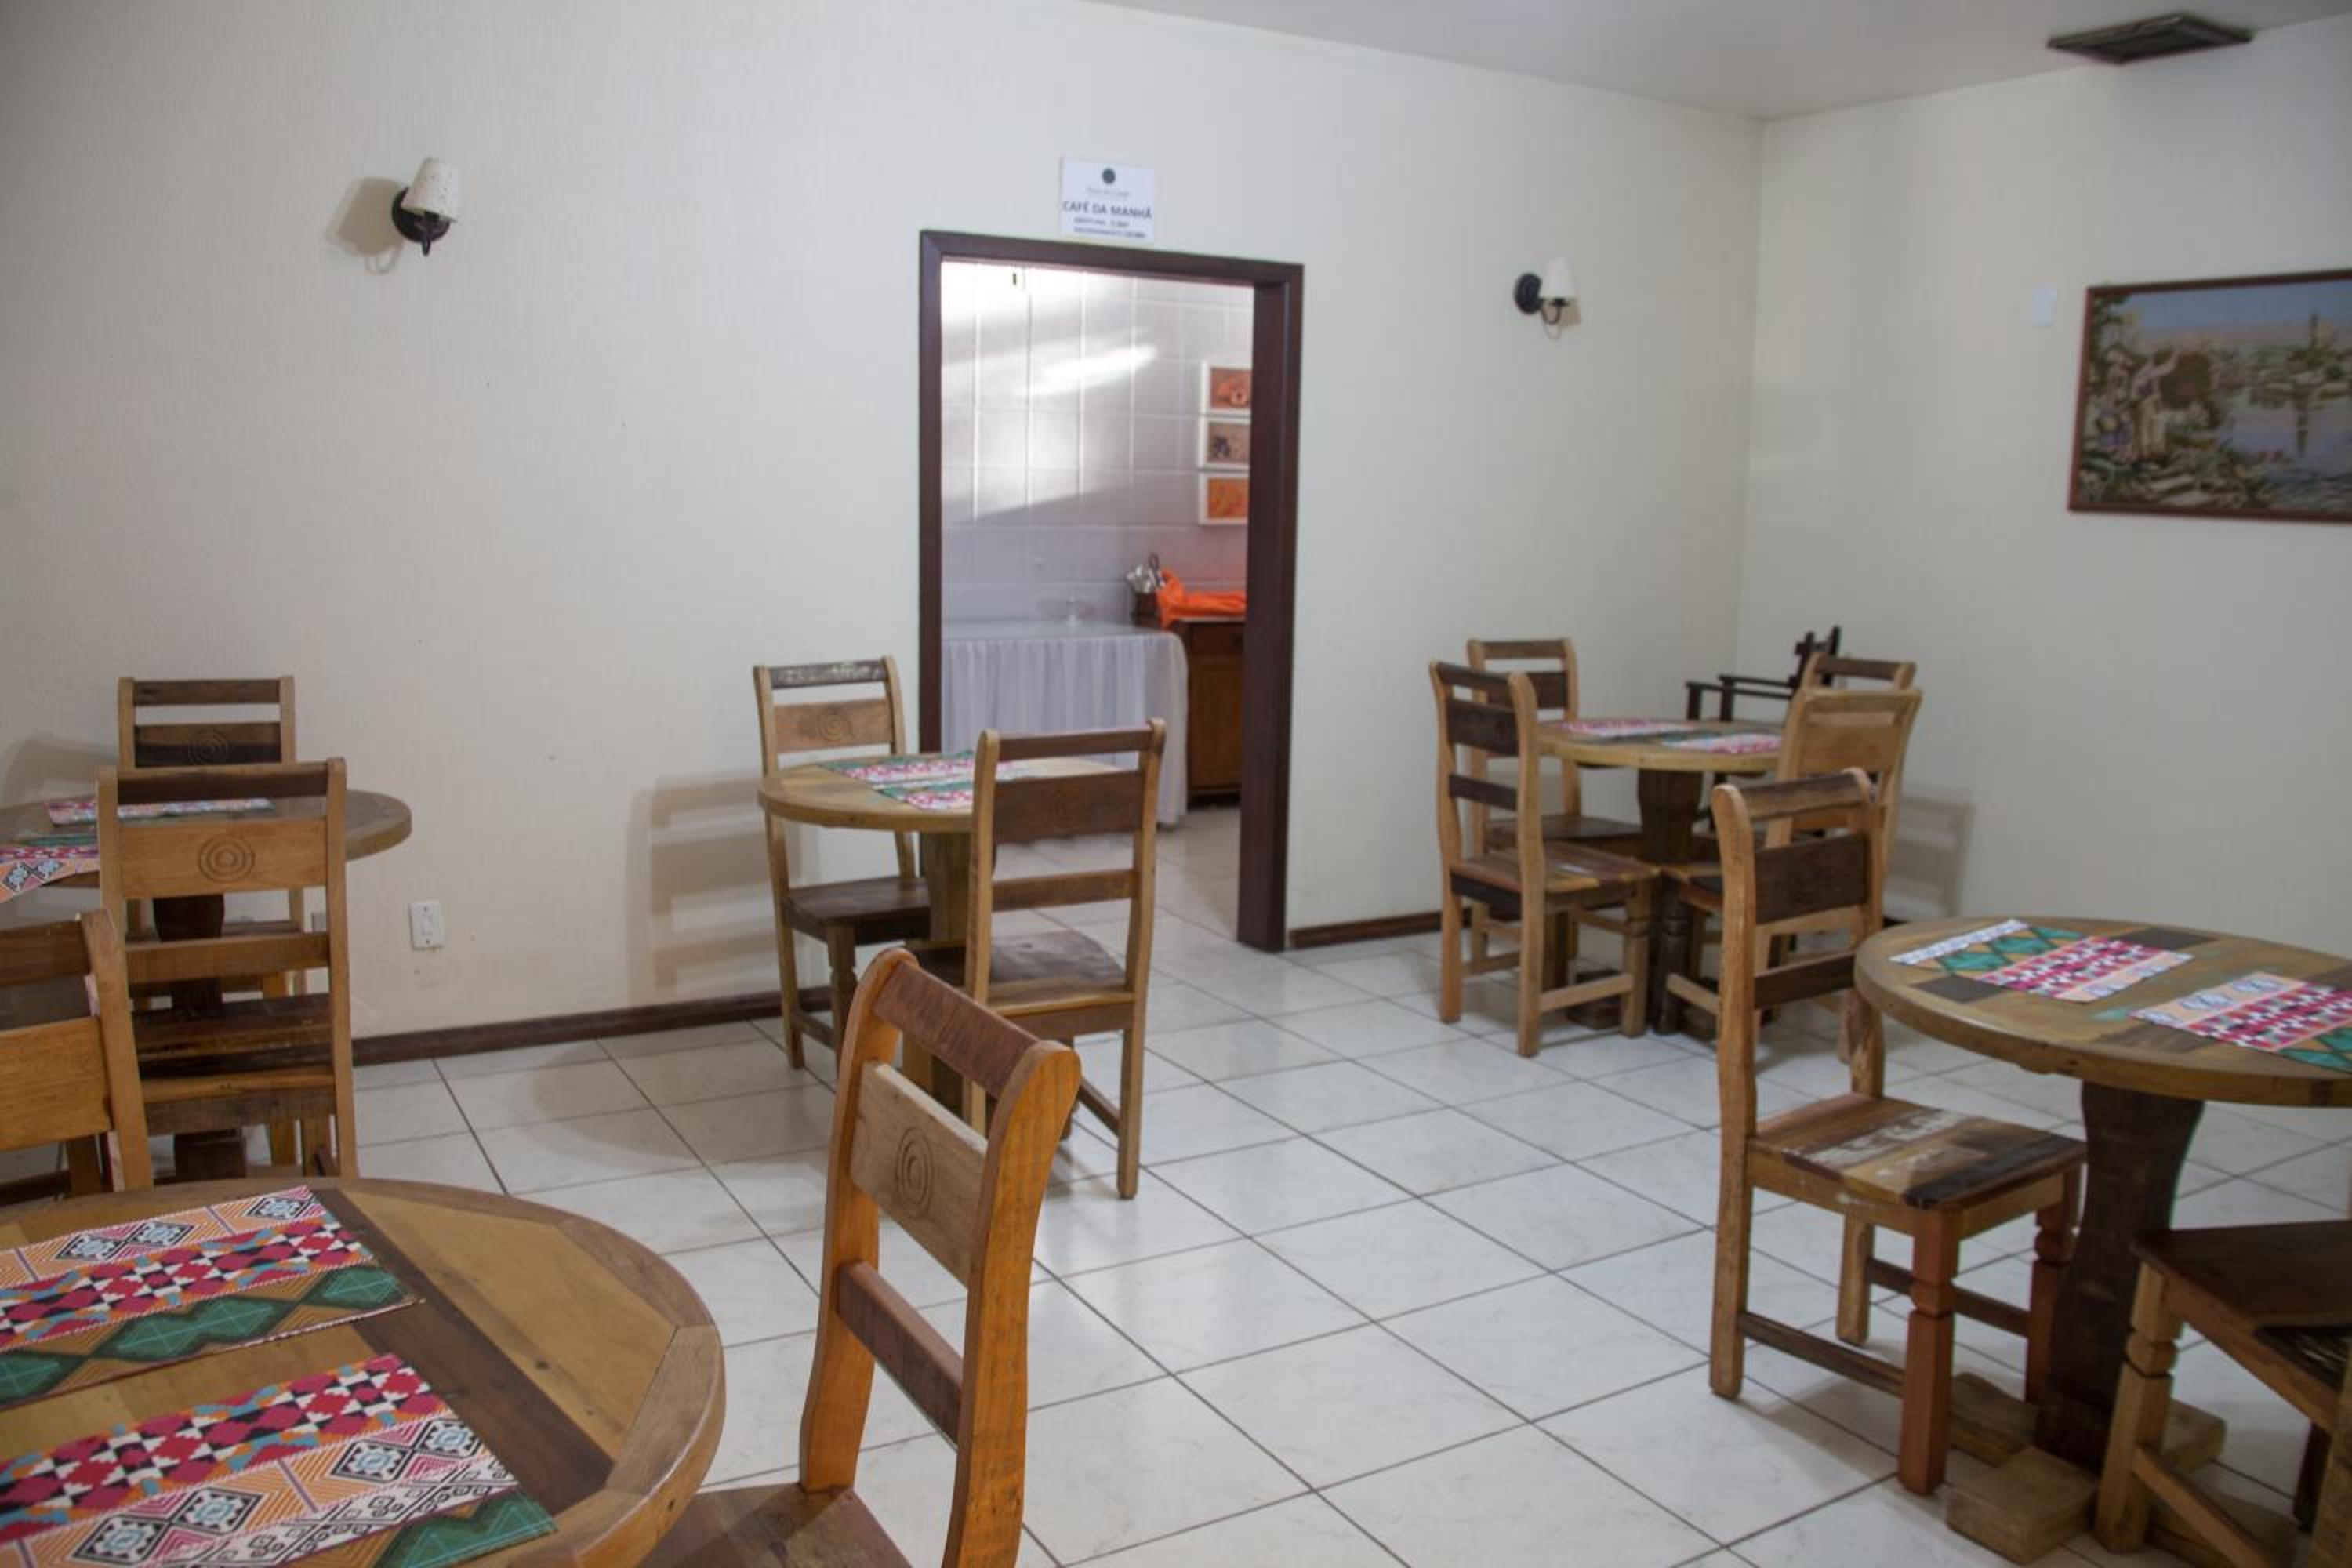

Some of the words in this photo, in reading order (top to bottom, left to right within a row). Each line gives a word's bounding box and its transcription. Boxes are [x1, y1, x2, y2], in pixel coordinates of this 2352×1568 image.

[1062, 200, 1089, 213] CAFÉ
[1092, 203, 1108, 213] DA
[1111, 205, 1152, 218] MANHÃ
